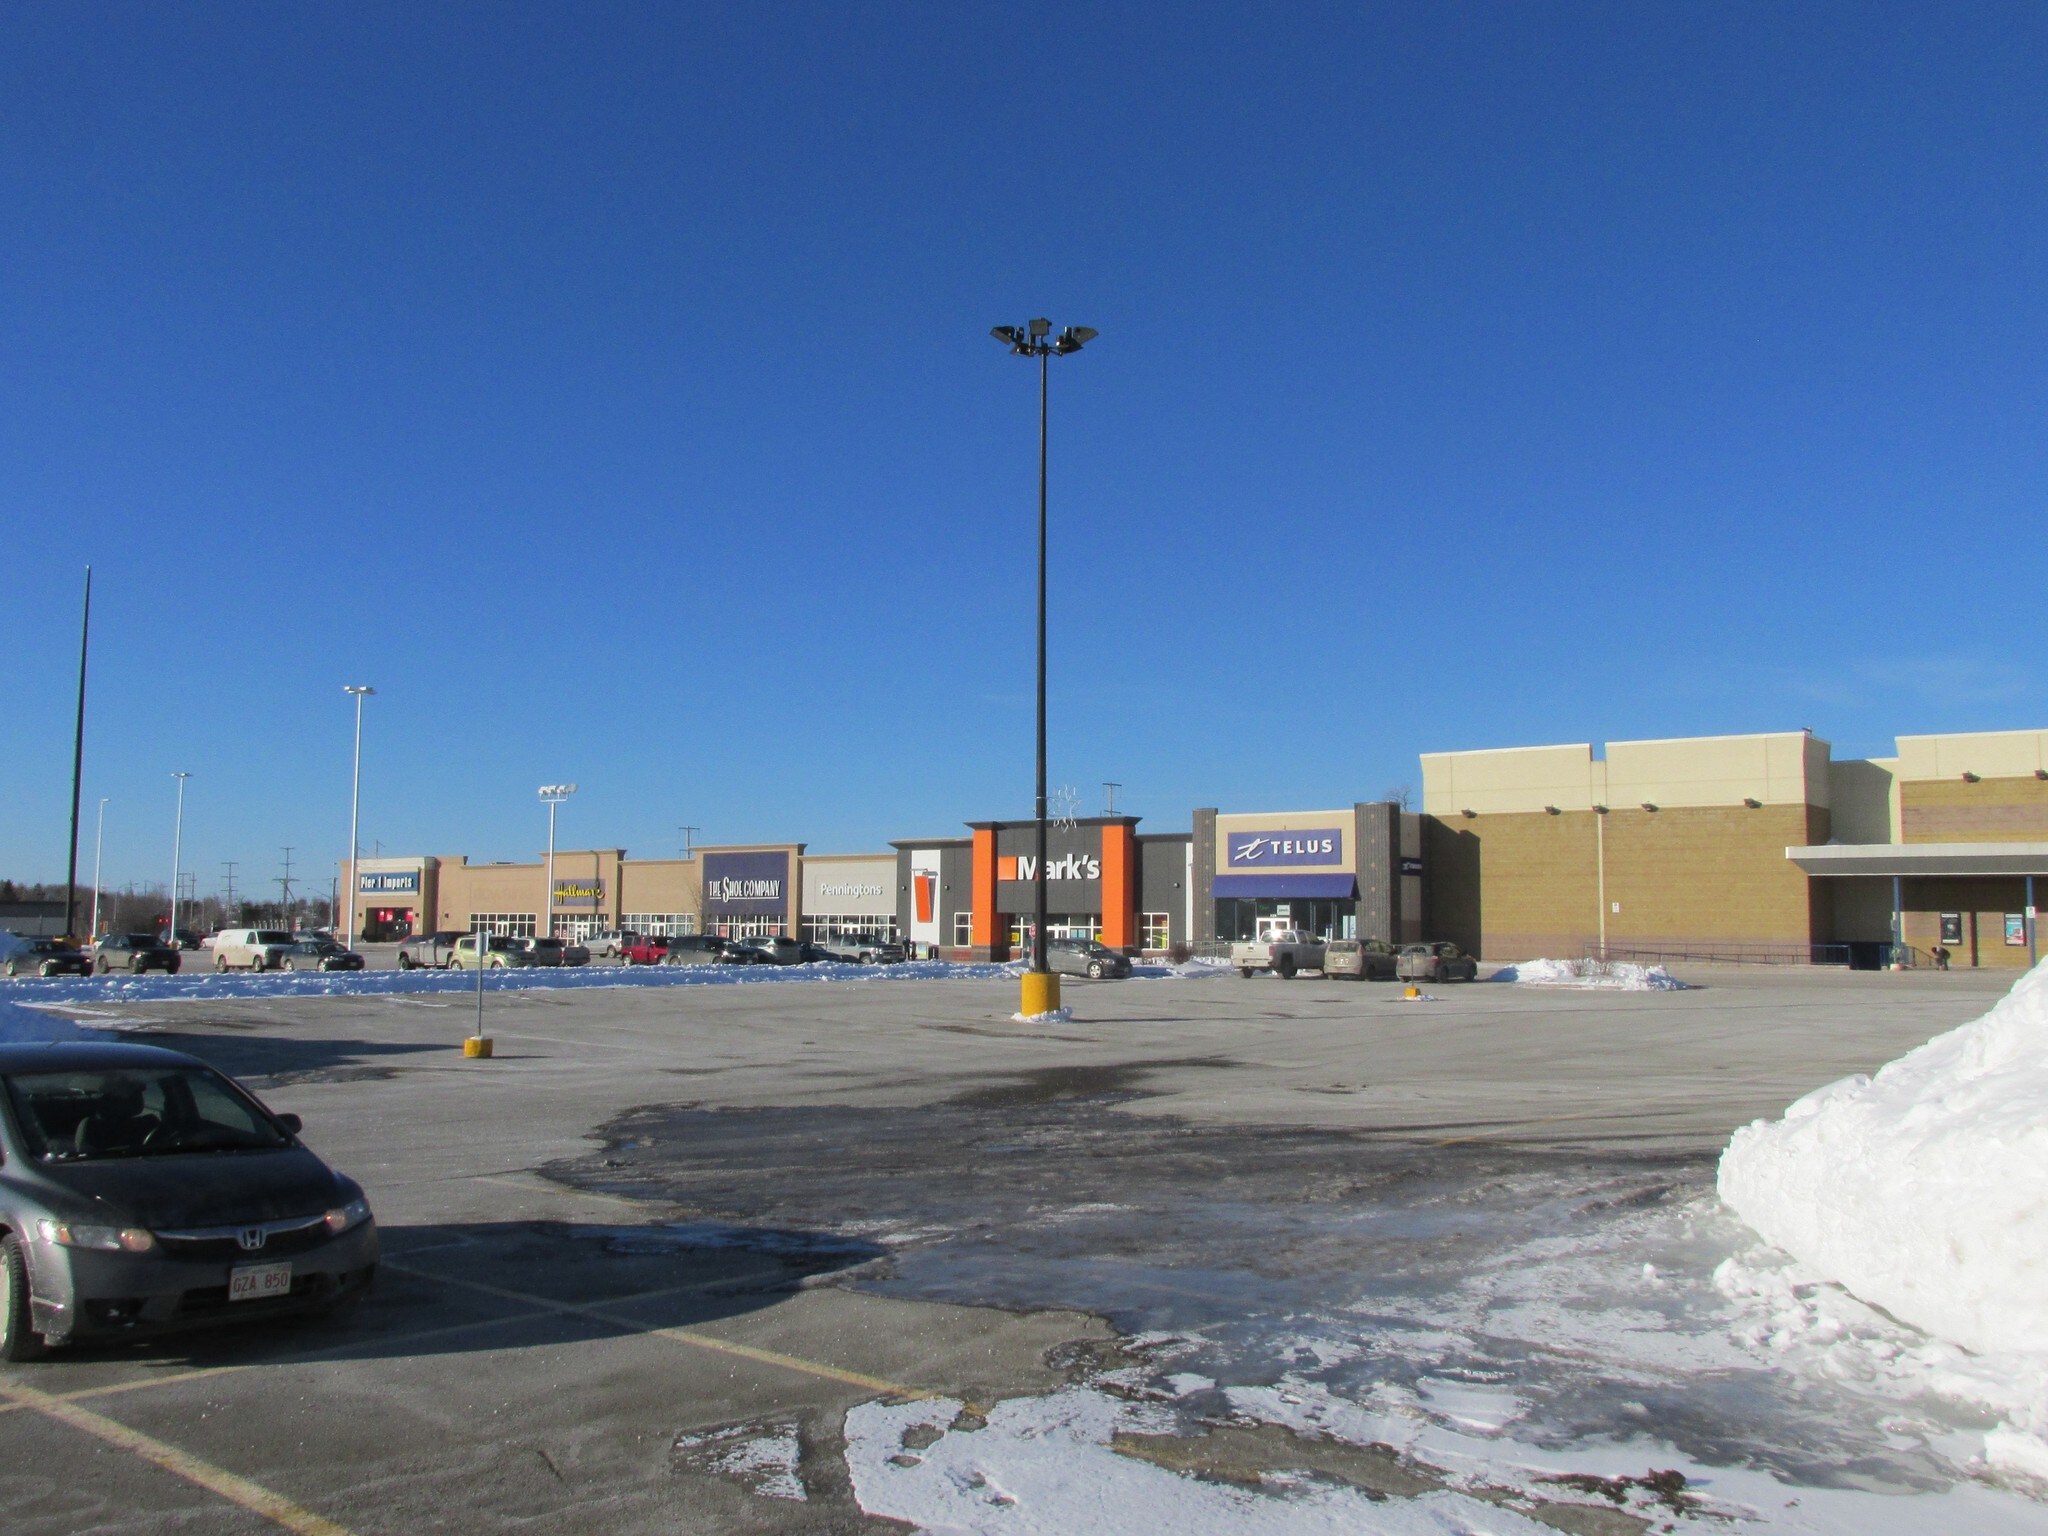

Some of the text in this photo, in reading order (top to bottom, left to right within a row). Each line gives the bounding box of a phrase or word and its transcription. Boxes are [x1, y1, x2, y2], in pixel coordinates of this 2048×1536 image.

[1270, 839, 1333, 854] TELUS
[1017, 853, 1101, 880] Mark's
[361, 876, 376, 888] Pier
[384, 876, 413, 890] Imports
[709, 876, 781, 903] THE SHOE COMPANY
[820, 882, 883, 899] Penningtons
[234, 1272, 288, 1292] GZA 850
